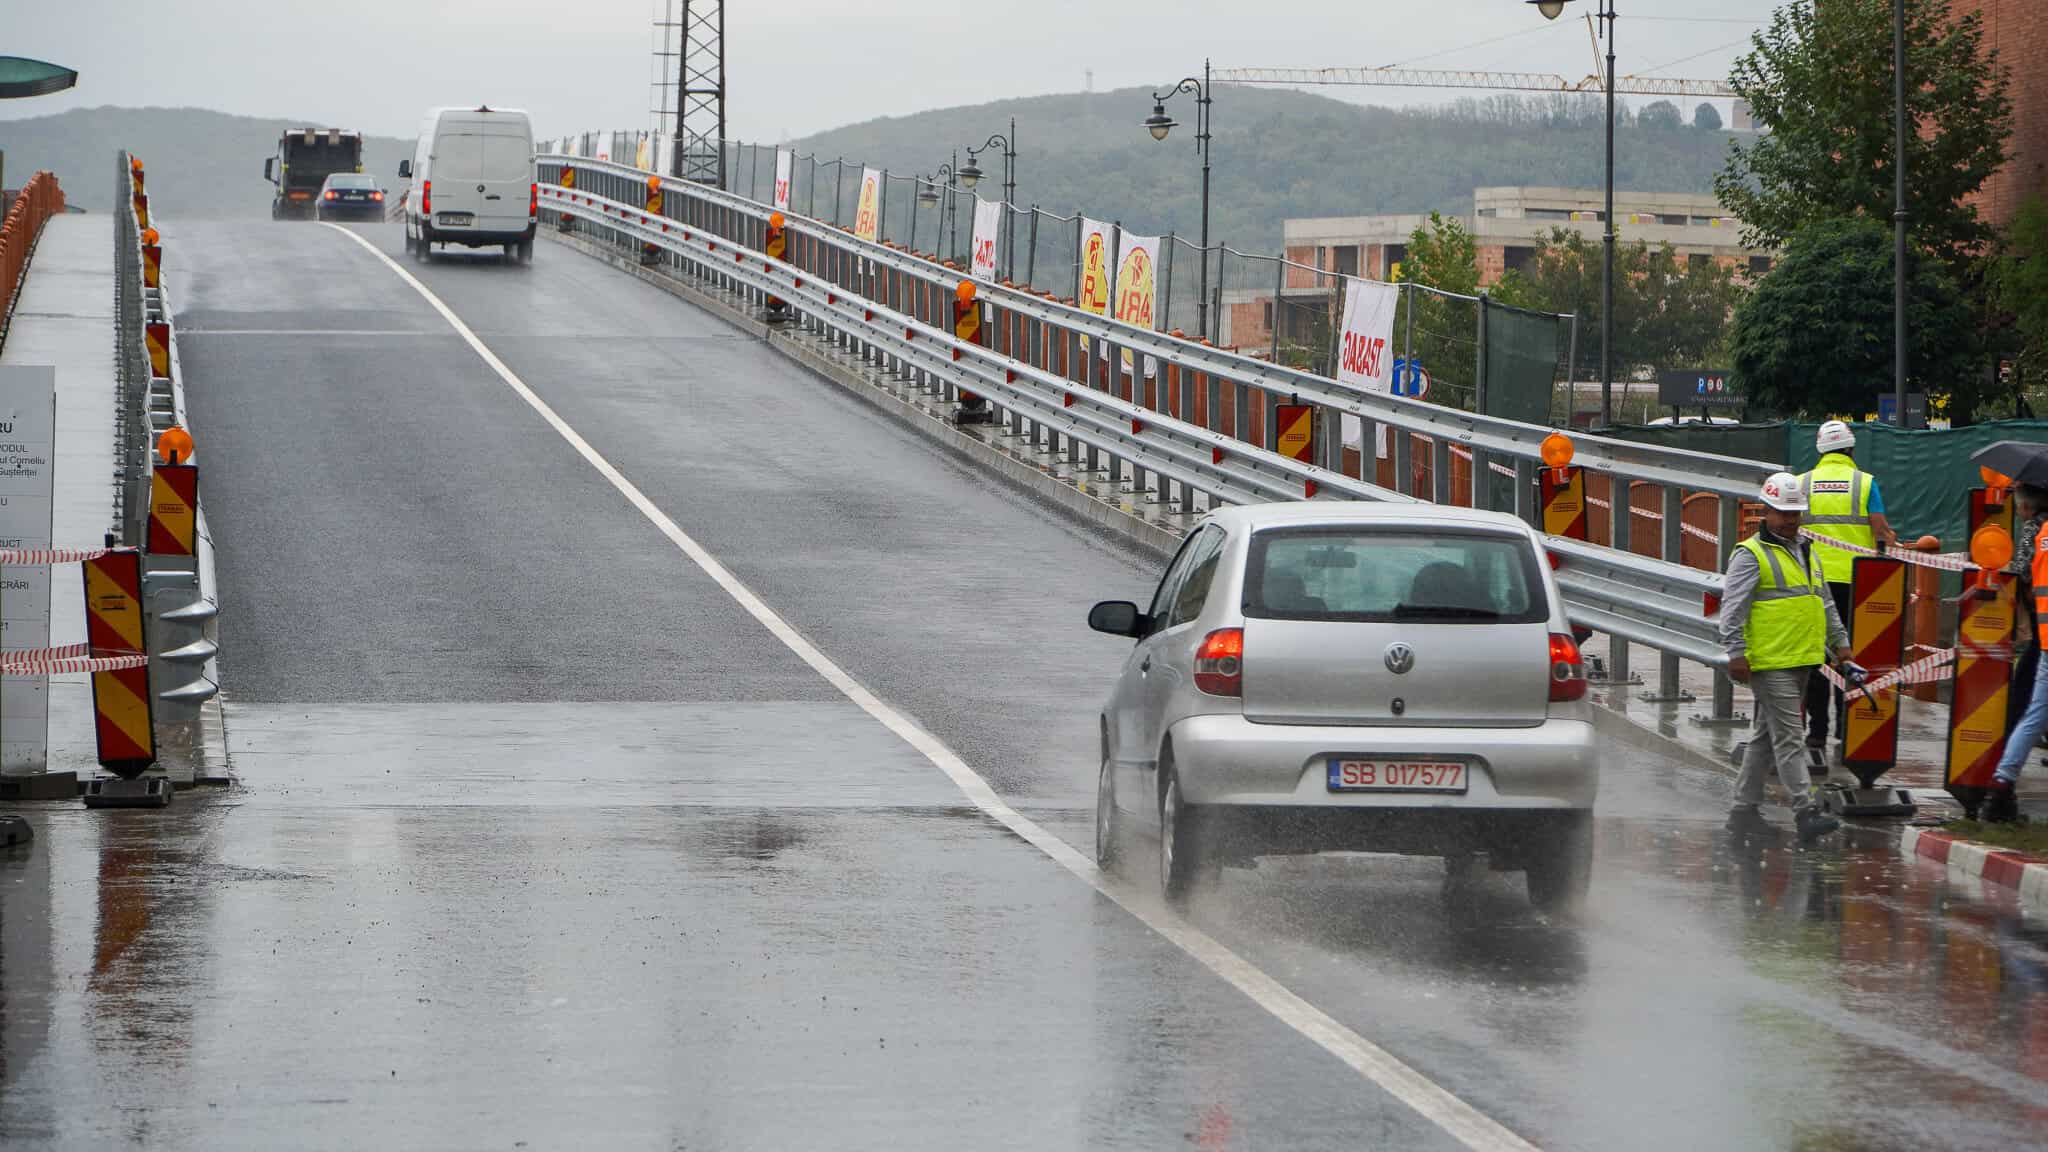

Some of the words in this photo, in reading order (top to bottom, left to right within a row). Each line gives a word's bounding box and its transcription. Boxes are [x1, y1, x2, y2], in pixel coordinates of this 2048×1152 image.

[0, 444, 30, 453] ODUL
[1343, 763, 1376, 785] SB
[1385, 763, 1462, 786] 017577
